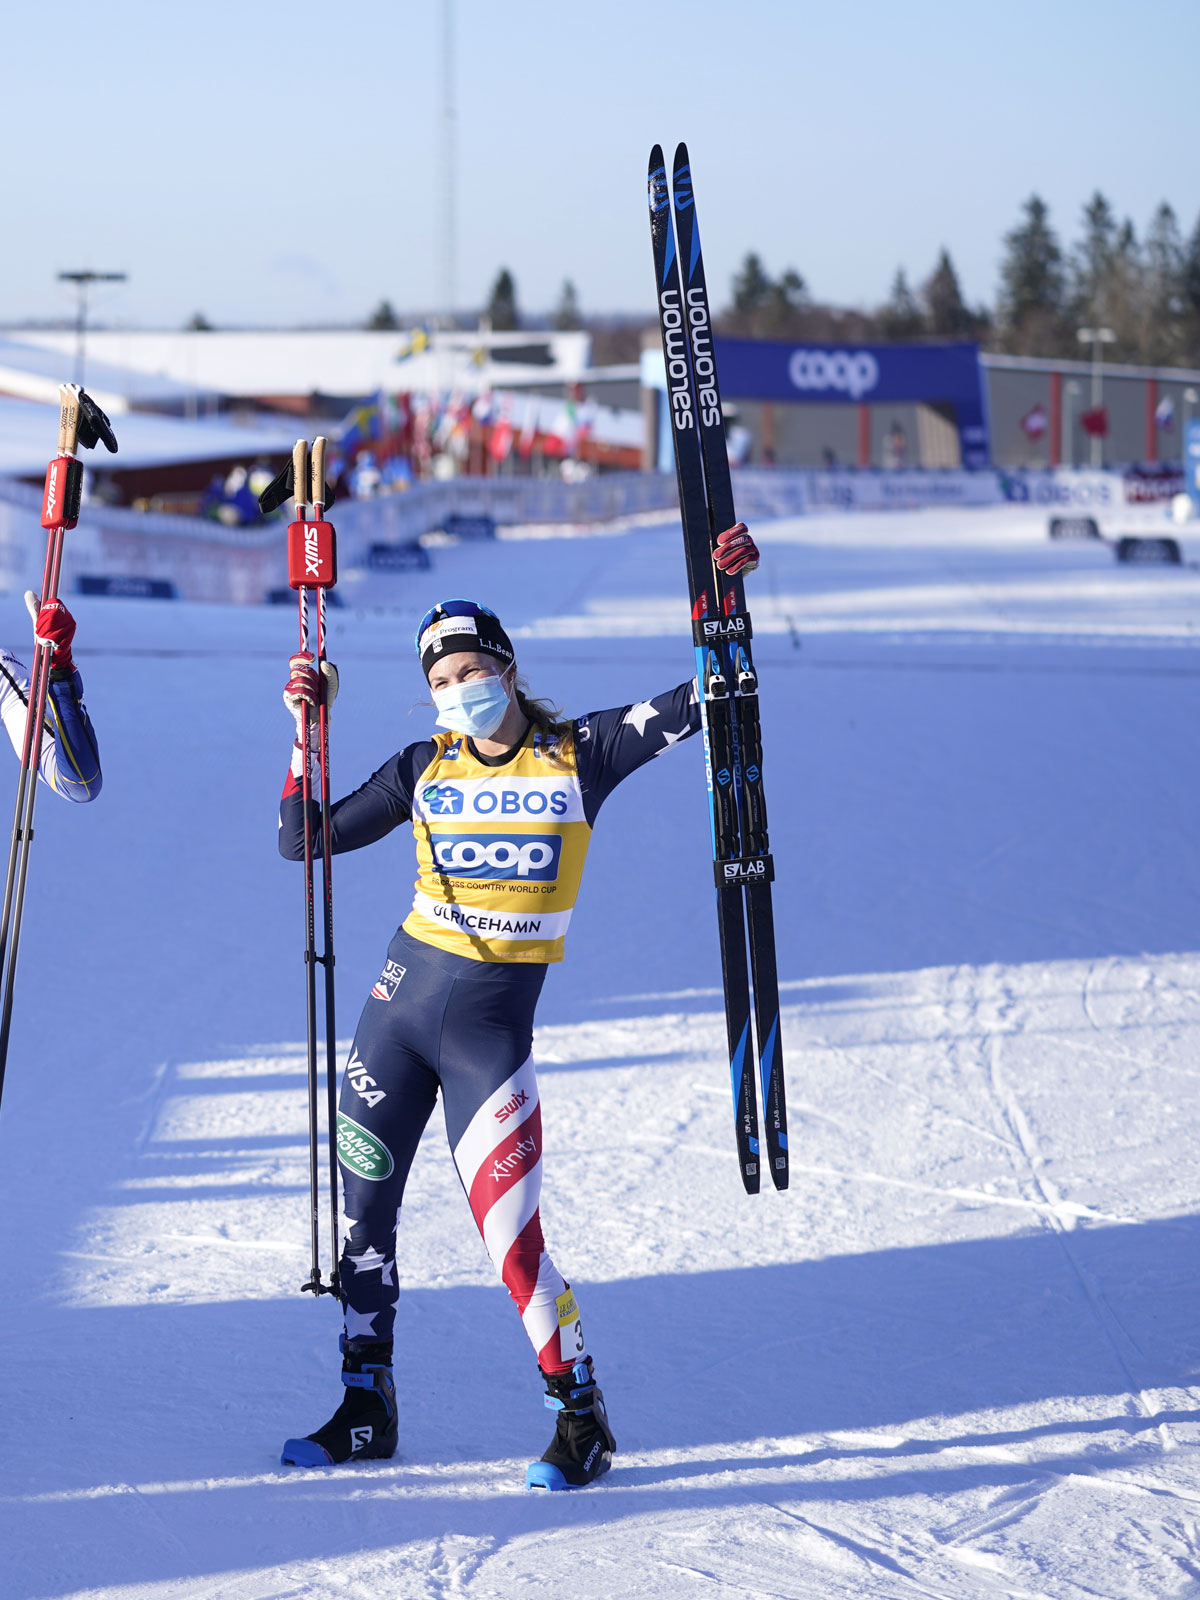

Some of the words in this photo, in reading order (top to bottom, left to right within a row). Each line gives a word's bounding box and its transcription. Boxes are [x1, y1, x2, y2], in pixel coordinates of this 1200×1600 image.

[660, 290, 693, 431] salomon
[686, 287, 721, 428] salomon
[789, 350, 878, 400] coop
[473, 790, 568, 816] OBOS
[435, 841, 554, 876] coop
[441, 879, 465, 889] CROSS
[466, 882, 506, 892] COUNTRY
[508, 885, 539, 894] WORLD
[541, 885, 557, 894] CUP
[433, 904, 541, 934] ULRICEHAMN
[385, 961, 405, 979] US
[347, 1046, 387, 1109] VISA
[337, 1132, 376, 1172] ROVER
[338, 1123, 376, 1158] LAND
[488, 1135, 537, 1182] xfinity
[574, 1319, 584, 1352] 3
